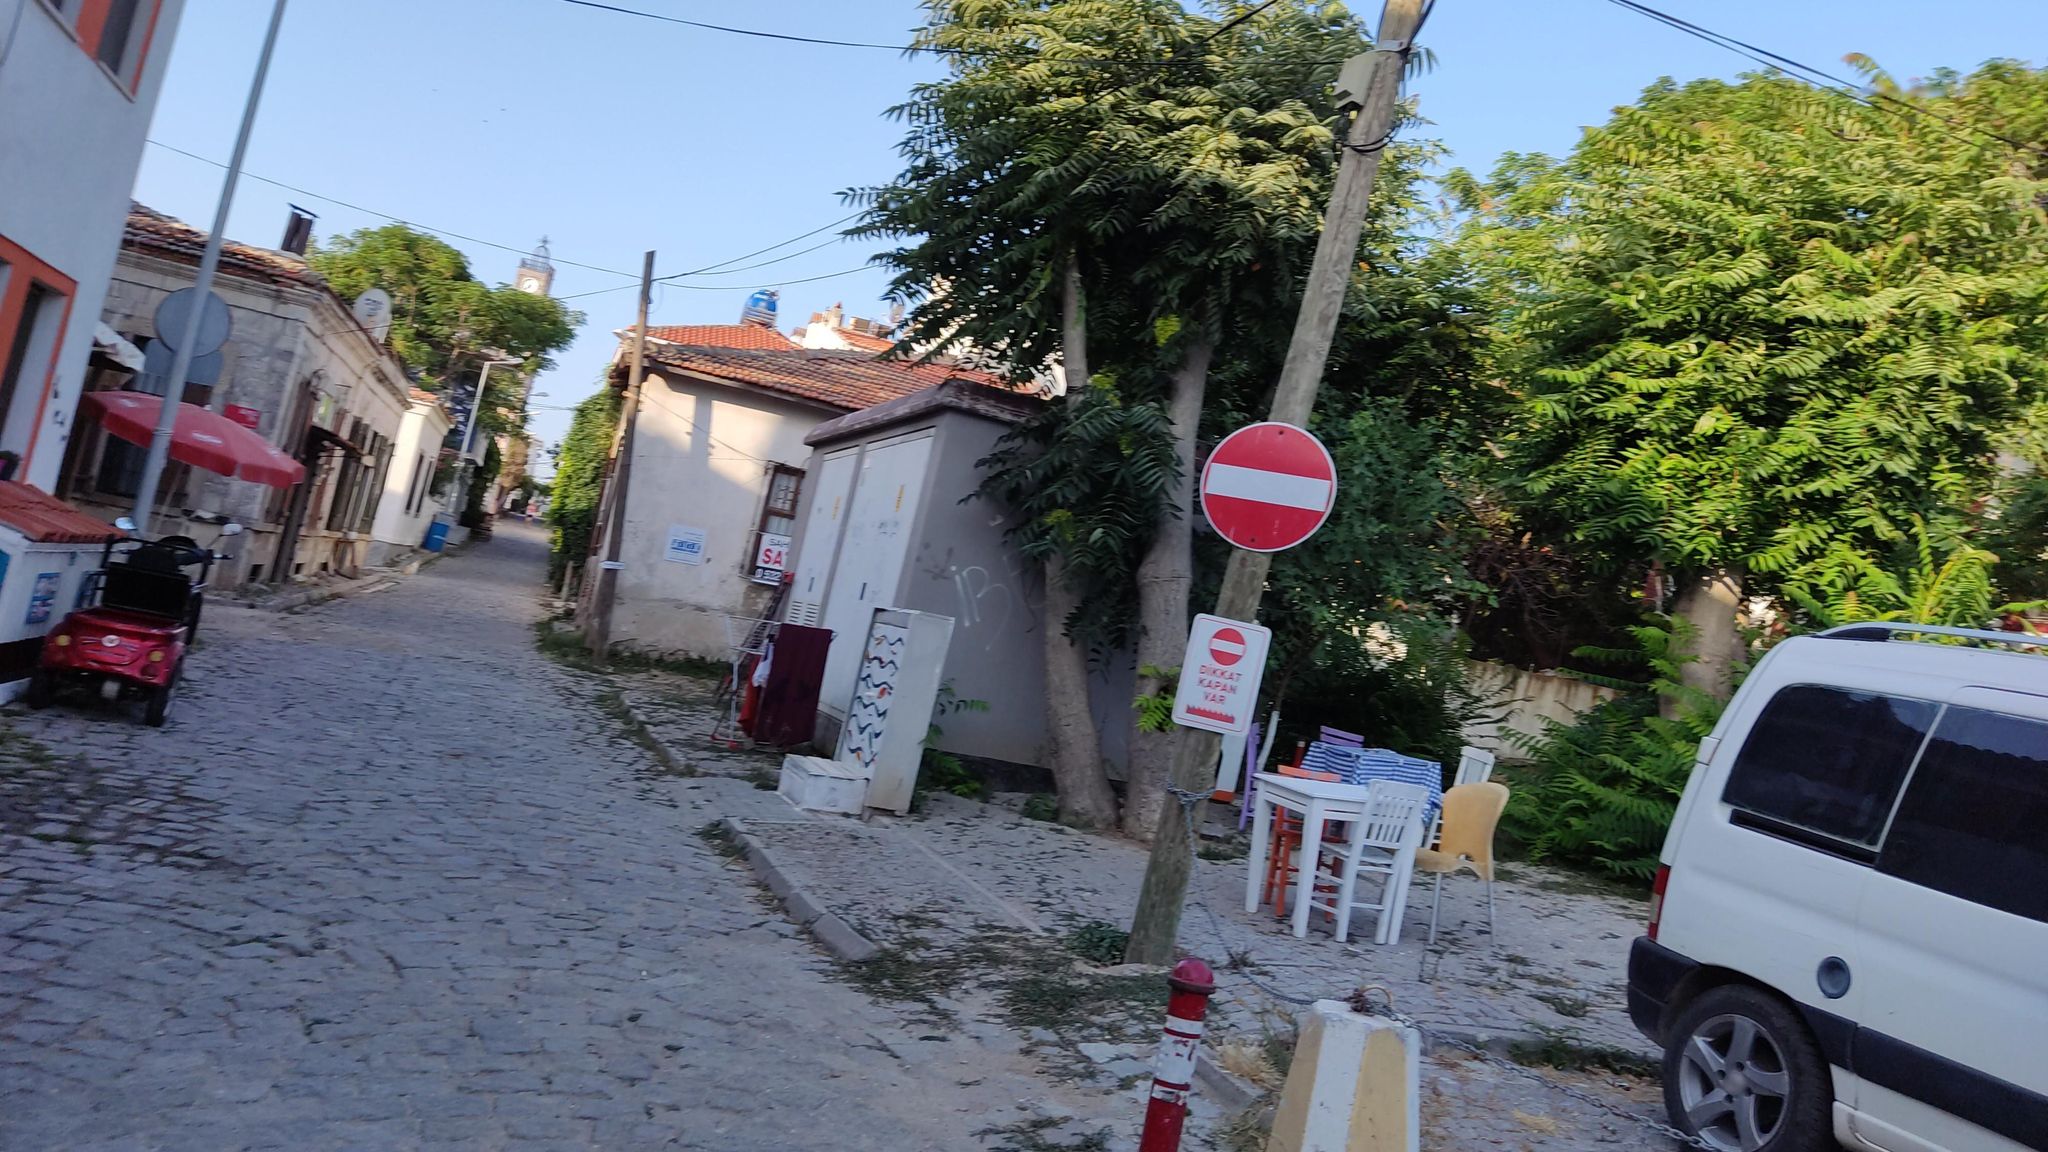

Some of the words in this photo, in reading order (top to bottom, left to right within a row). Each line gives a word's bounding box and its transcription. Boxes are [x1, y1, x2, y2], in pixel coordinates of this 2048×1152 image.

[1199, 664, 1243, 682] DİKKAT
[1197, 677, 1237, 694] KAPAN
[1203, 691, 1226, 705] VAR
